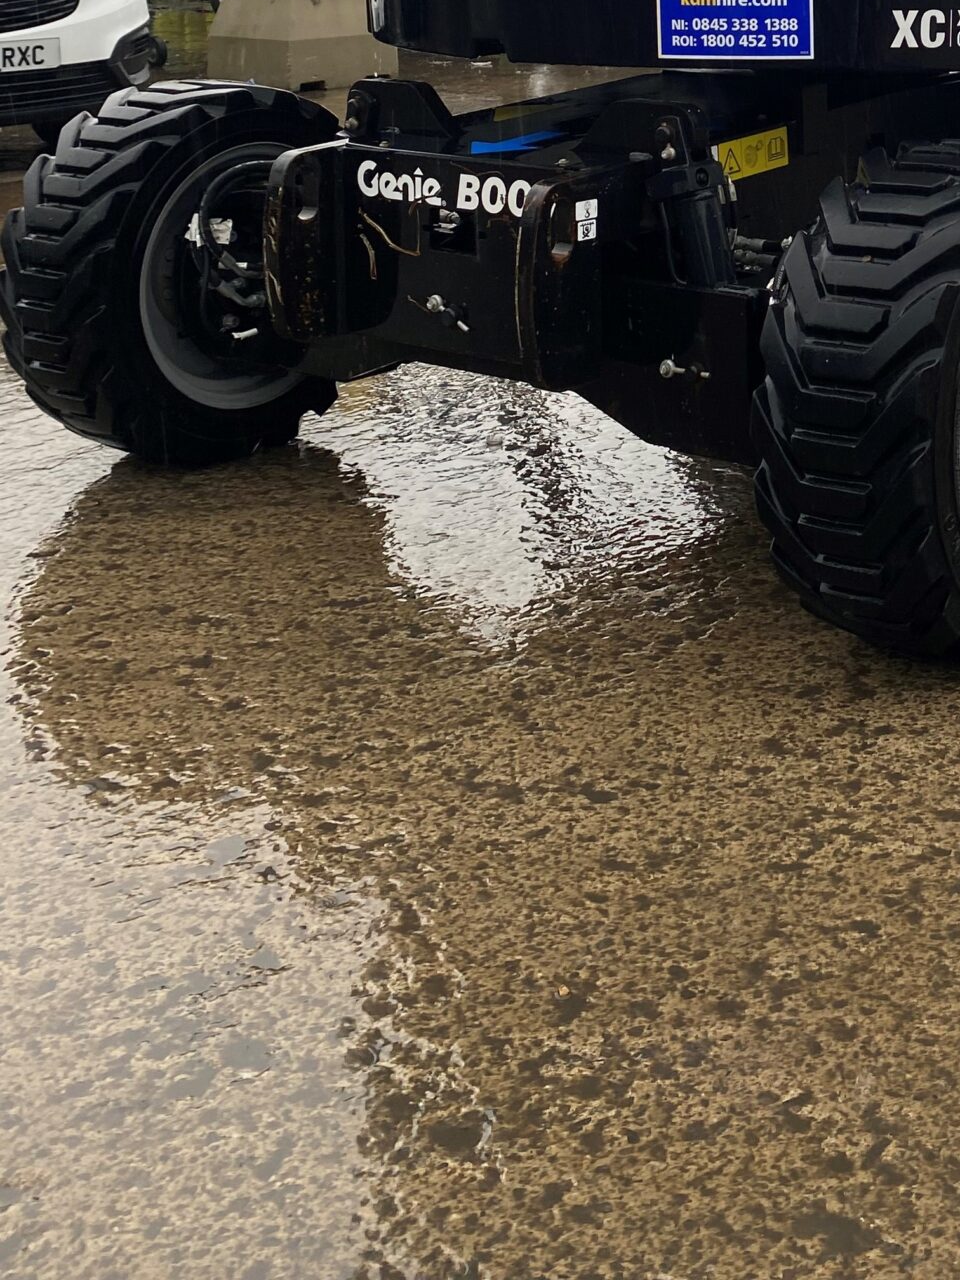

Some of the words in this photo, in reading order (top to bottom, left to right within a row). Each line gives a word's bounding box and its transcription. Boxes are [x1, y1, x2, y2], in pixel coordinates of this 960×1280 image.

[671, 19, 689, 30] NI:
[692, 18, 728, 31] 0845
[731, 18, 758, 31] 338
[764, 18, 798, 31] 1388
[890, 9, 946, 49] XC
[672, 35, 697, 47] ROI:
[700, 34, 735, 47] 1800
[738, 35, 767, 47] 452
[772, 34, 798, 47] 510
[2, 45, 45, 68] RXC
[357, 160, 442, 206] Genie
